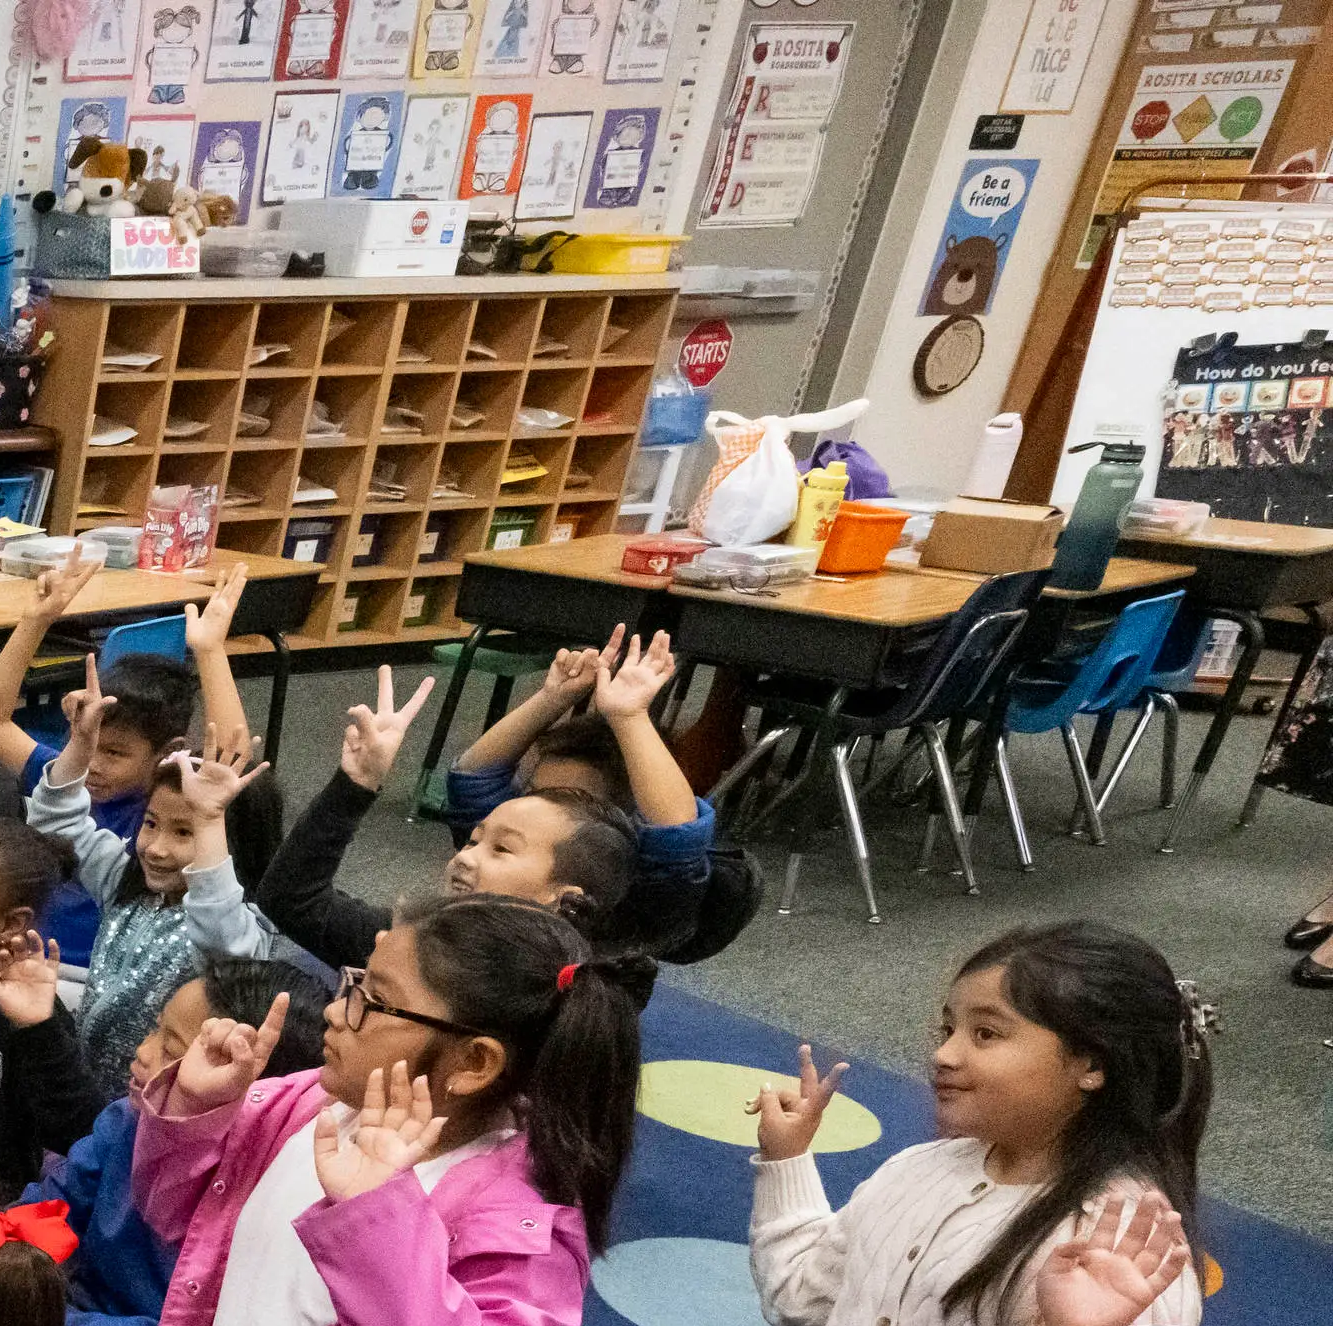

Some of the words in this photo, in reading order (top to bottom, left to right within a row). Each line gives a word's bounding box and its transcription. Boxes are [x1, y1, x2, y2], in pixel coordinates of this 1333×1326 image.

[773, 39, 823, 57] ROSITA
[1031, 47, 1070, 73] nice
[1144, 73, 1197, 87] ROSITA
[1202, 69, 1284, 86] SCHOLARS
[755, 85, 770, 111] R
[1134, 114, 1166, 126] STOP
[982, 175, 998, 189] Be
[1001, 177, 1010, 189] a
[729, 182, 745, 208] D
[969, 192, 1011, 207] friend.
[124, 221, 177, 246] BOO
[114, 247, 198, 268] BUDDIES
[683, 341, 729, 365] STARTS
[1196, 368, 1237, 381] How
[1241, 364, 1265, 379] do
[1271, 363, 1305, 380] you
